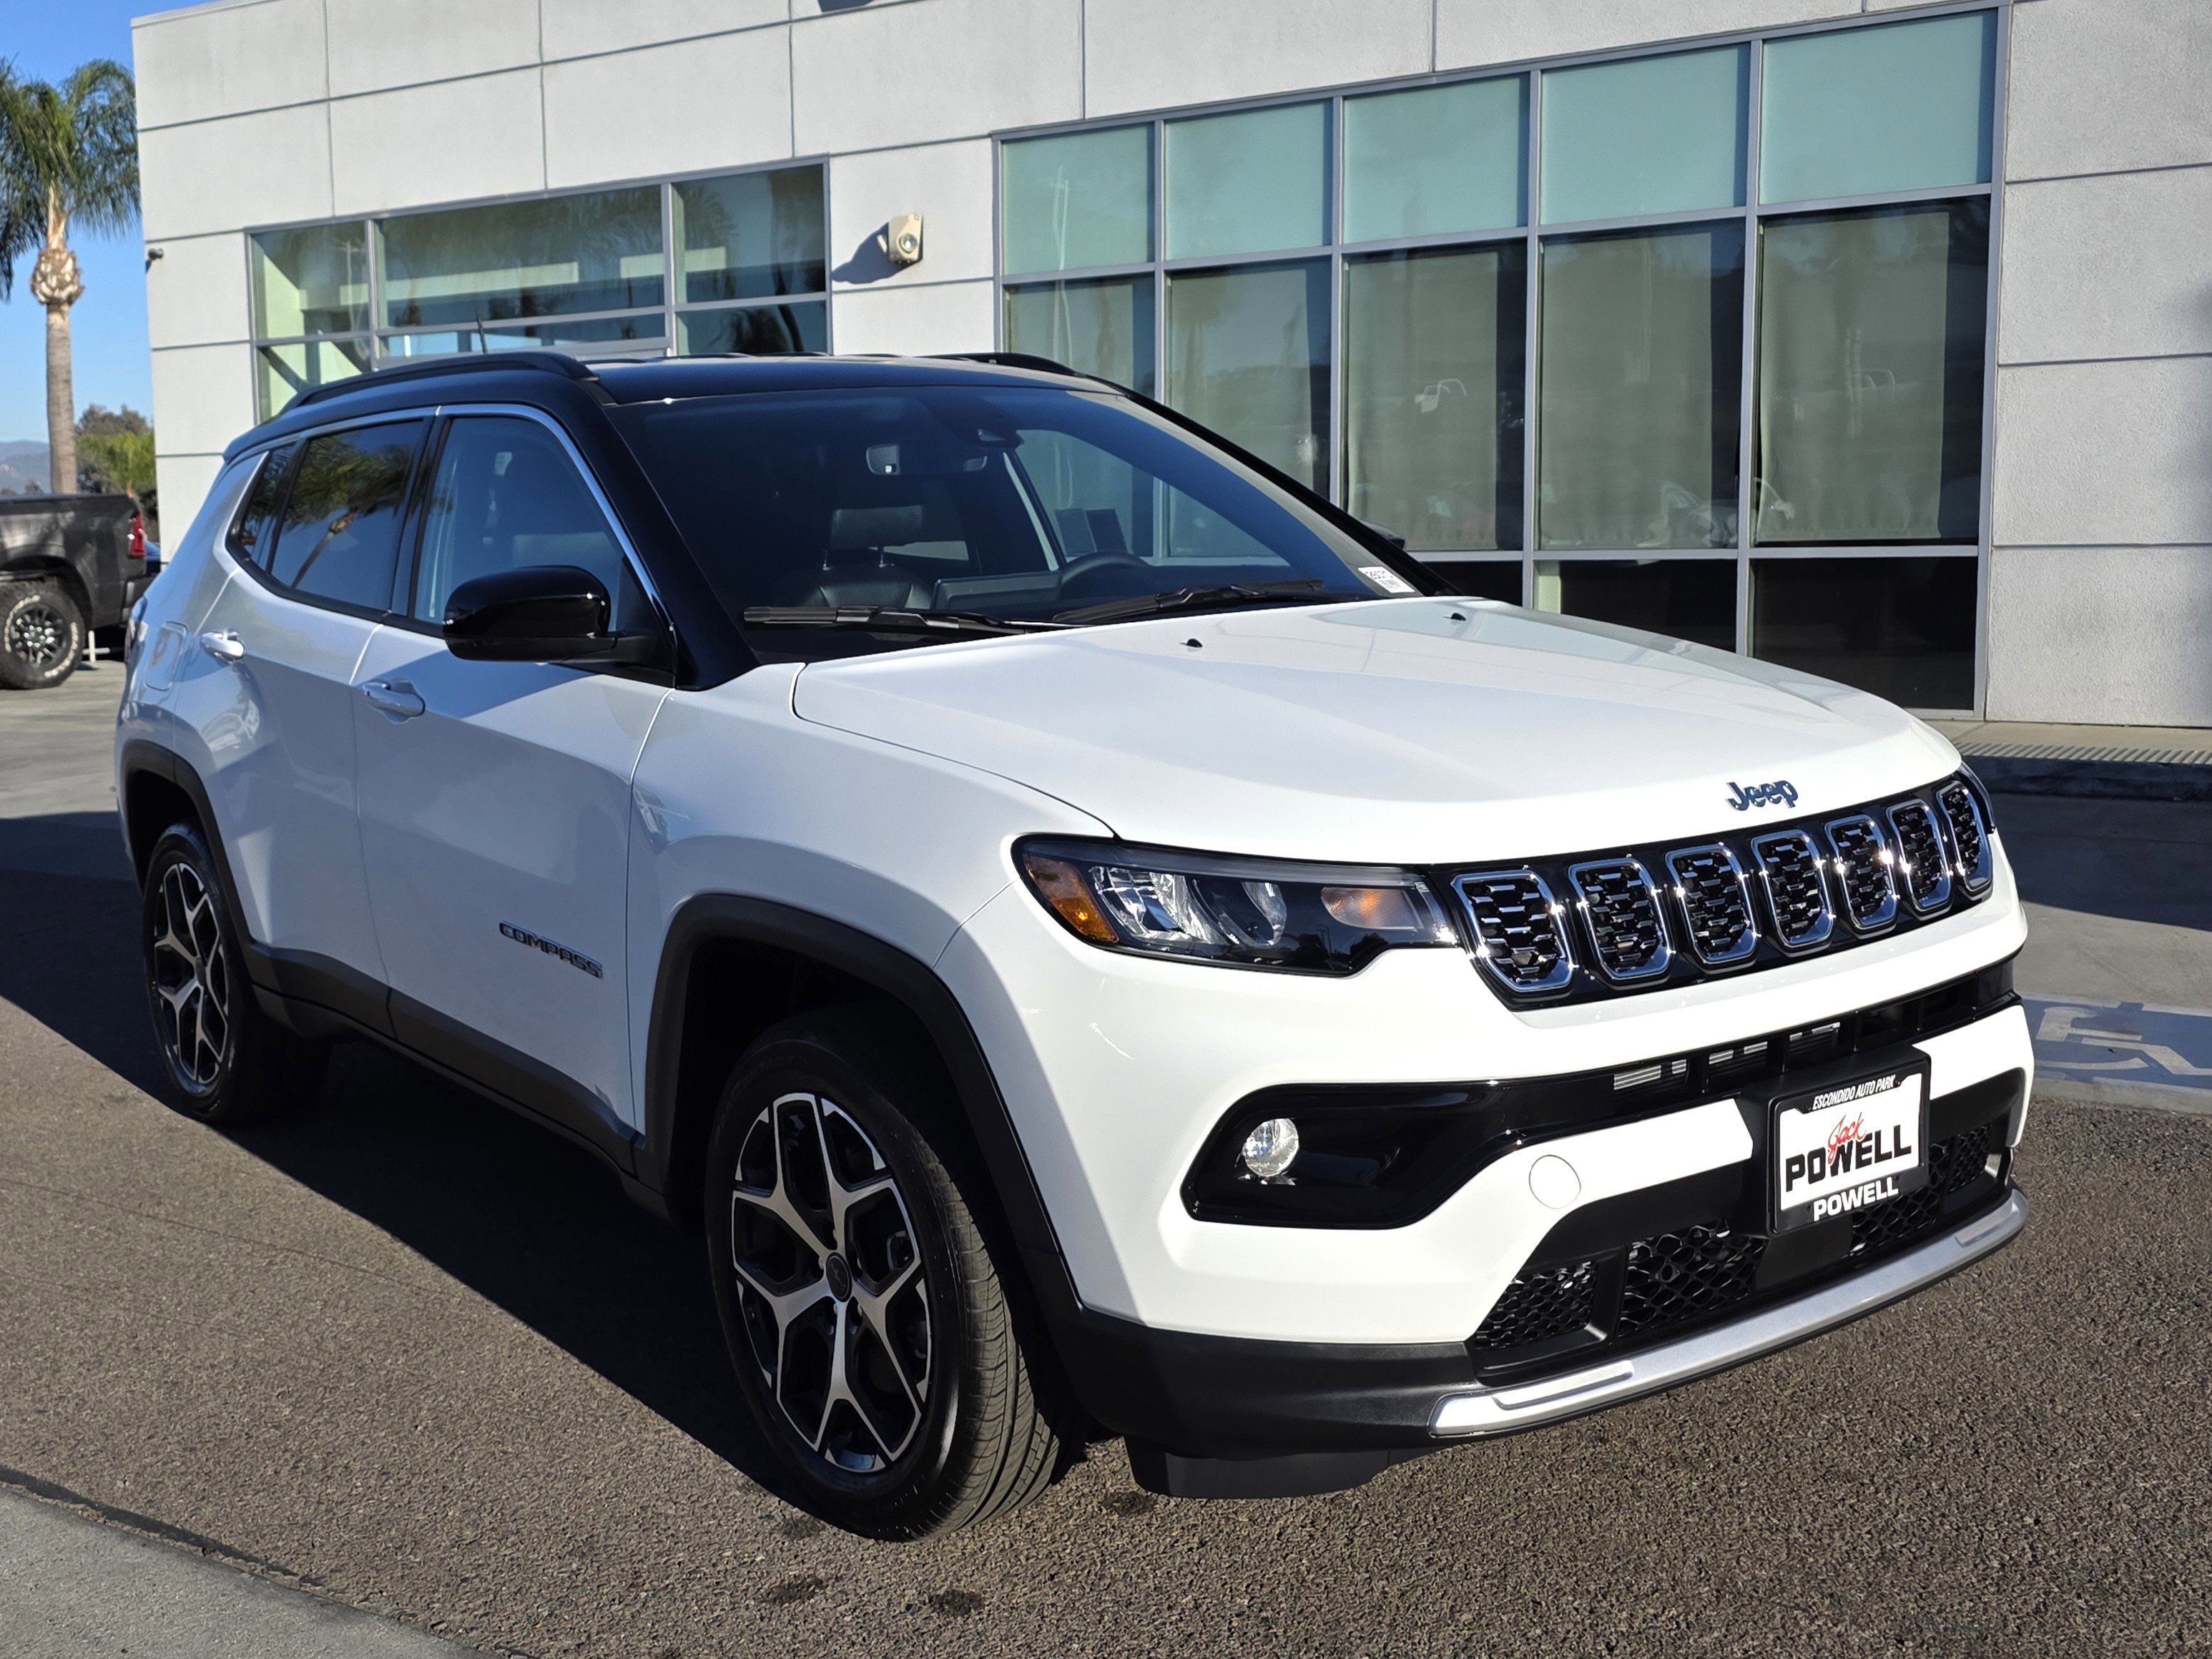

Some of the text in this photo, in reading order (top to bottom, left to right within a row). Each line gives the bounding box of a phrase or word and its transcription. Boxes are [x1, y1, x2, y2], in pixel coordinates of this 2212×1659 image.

[1726, 780, 1799, 811] Jeep
[499, 920, 604, 980] COMPASS
[1812, 1074, 1896, 1111] ESCONDIDO AUTO PARK
[1786, 1124, 1912, 1193] POWELL
[1828, 1111, 1867, 1164] Jack
[1813, 1176, 1899, 1222] POWELL
